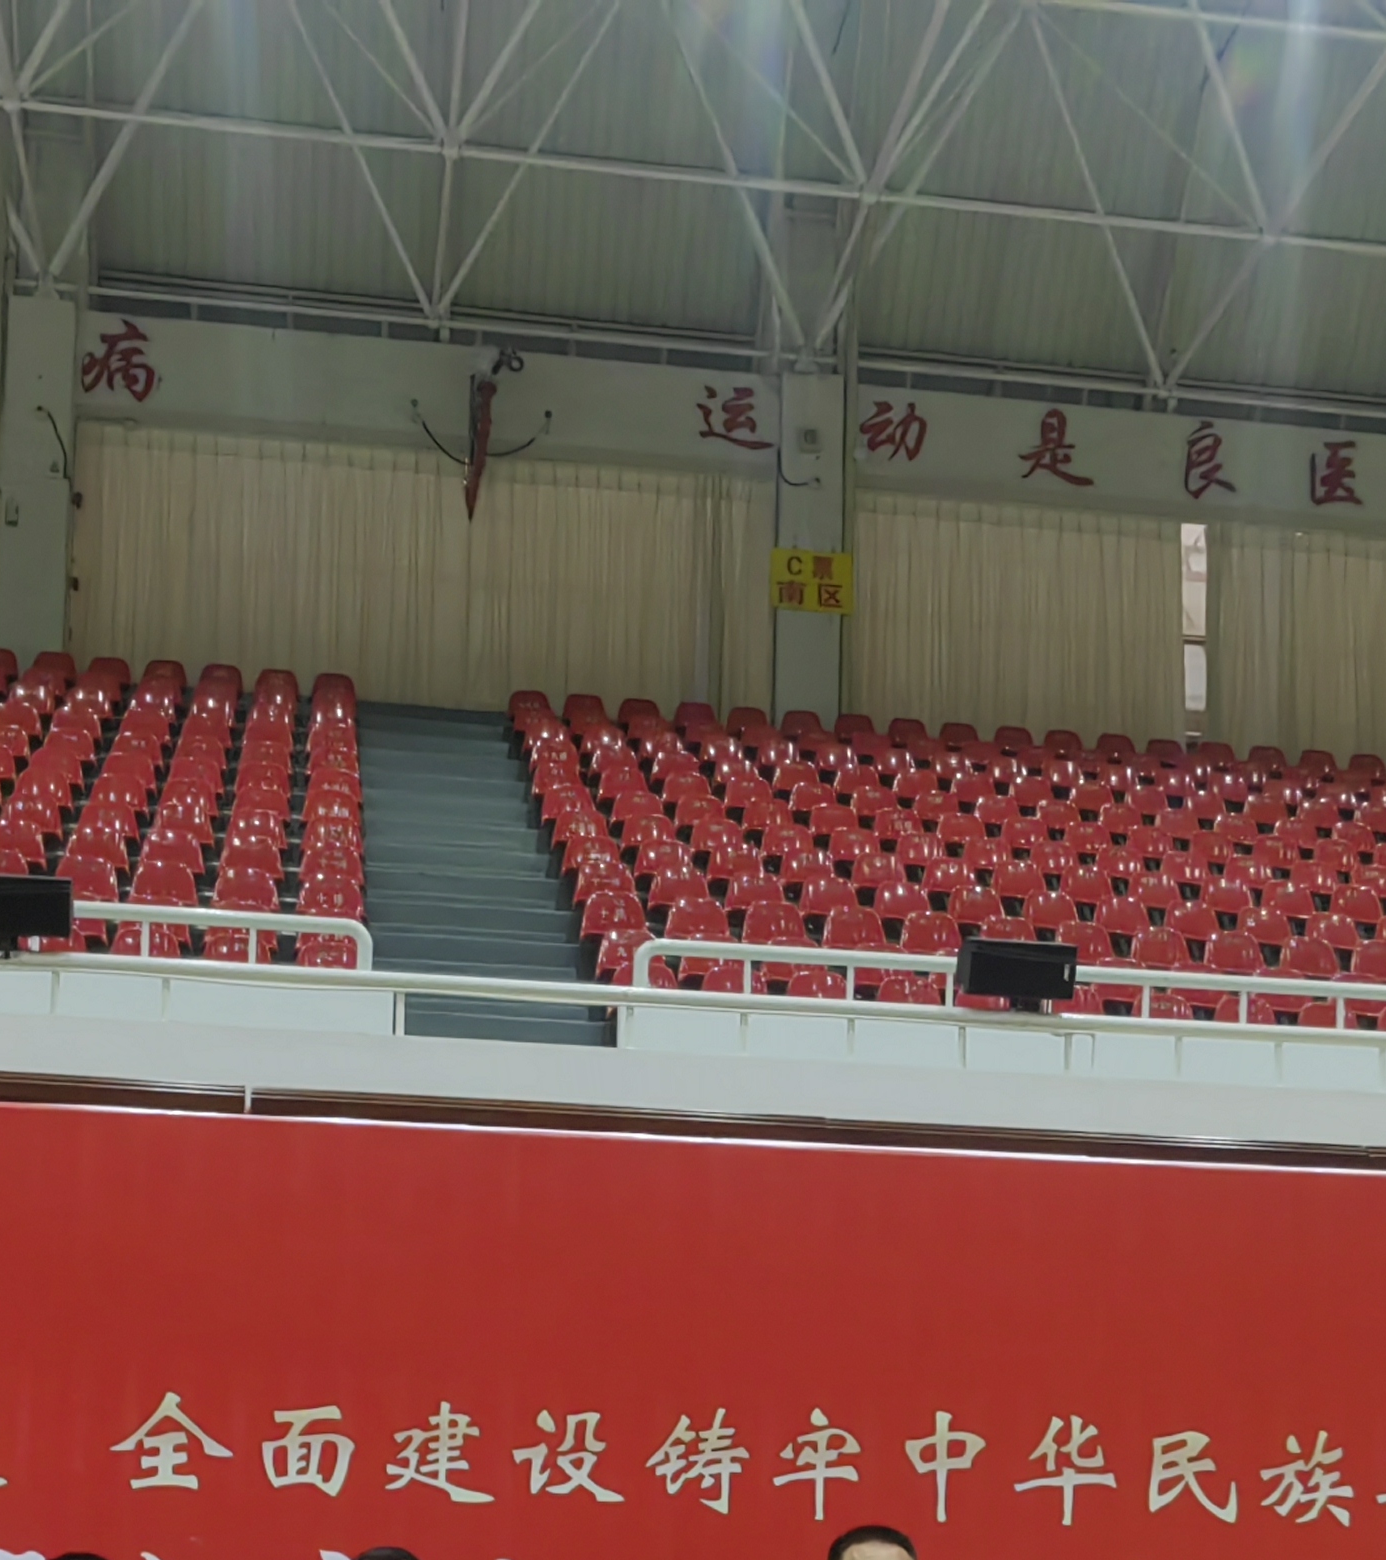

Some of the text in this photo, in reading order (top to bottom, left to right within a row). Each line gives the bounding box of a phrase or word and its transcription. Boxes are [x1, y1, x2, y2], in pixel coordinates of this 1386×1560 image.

[697, 386, 1364, 508] 运动是良医
